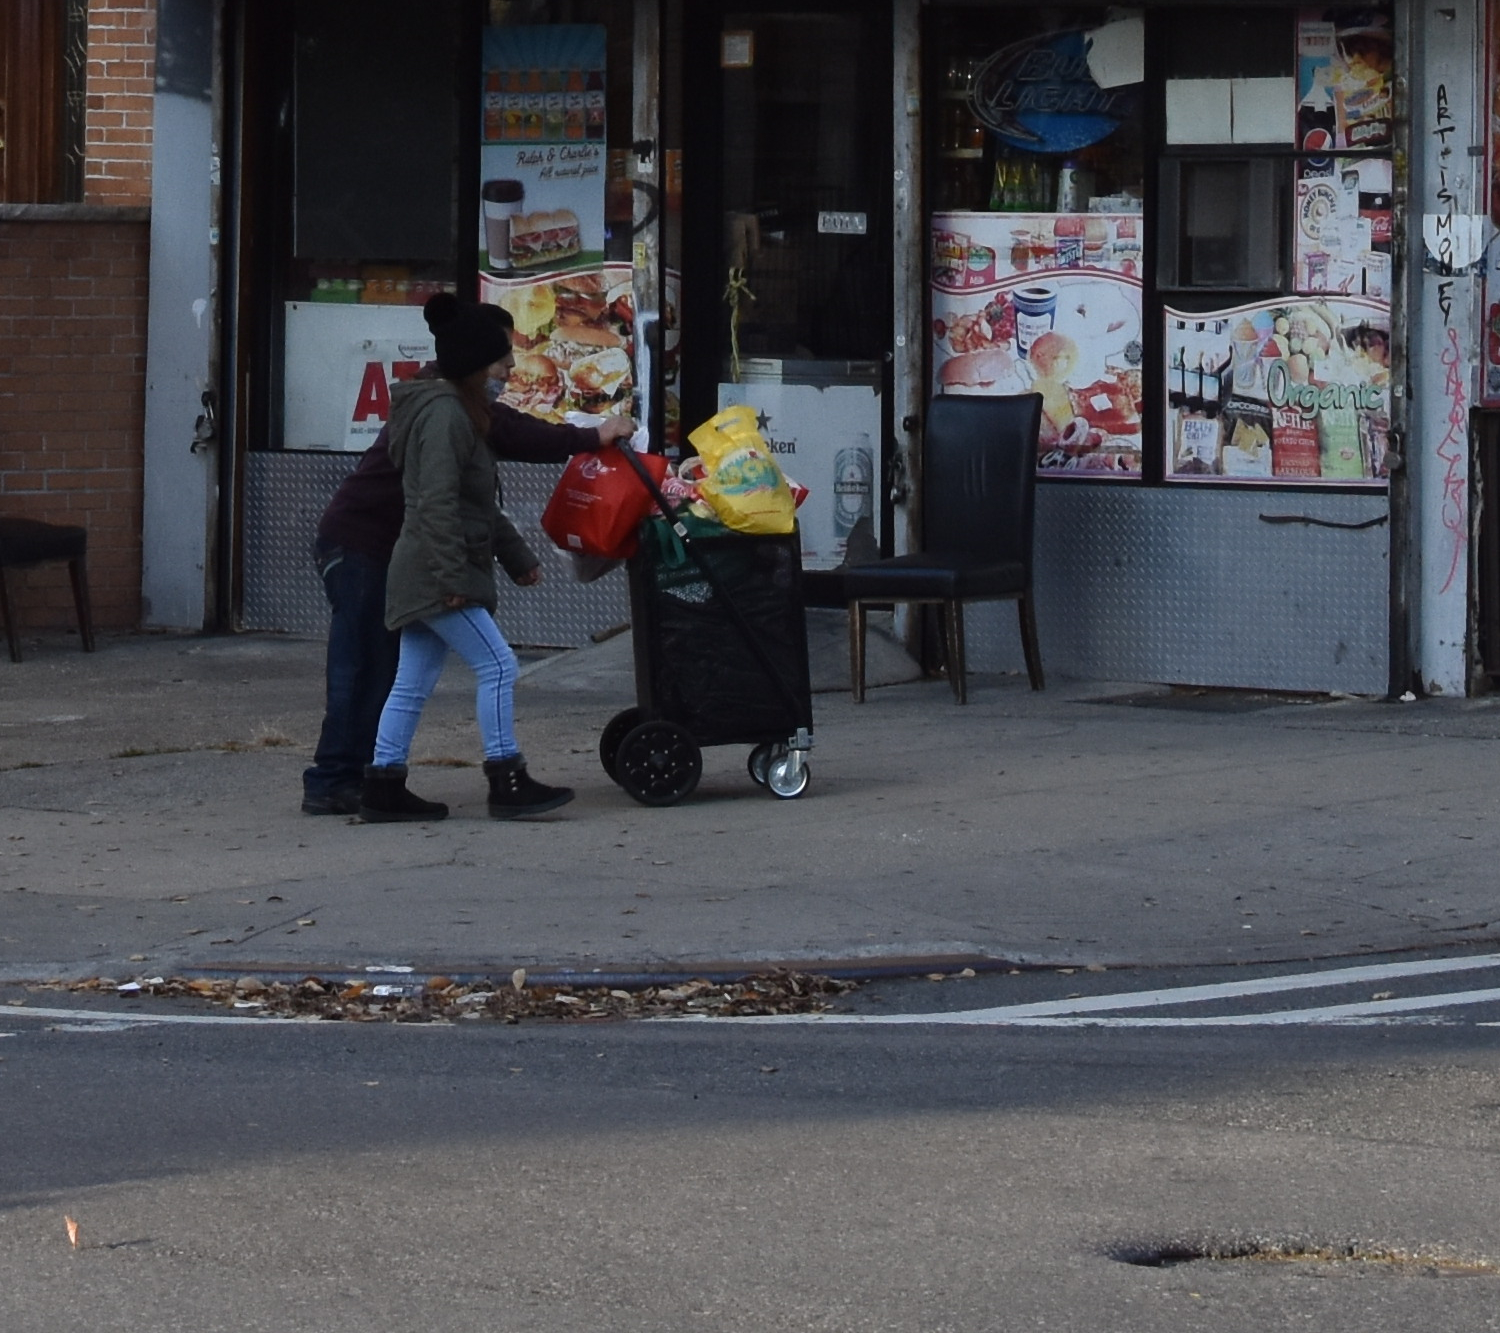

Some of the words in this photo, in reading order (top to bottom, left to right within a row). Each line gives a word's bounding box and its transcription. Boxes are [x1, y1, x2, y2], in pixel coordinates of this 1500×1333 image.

[517, 151, 543, 165] Ralph
[547, 148, 555, 161] &
[560, 144, 599, 160] Charlie's
[352, 361, 420, 421] AT
[1267, 359, 1384, 420] Organic
